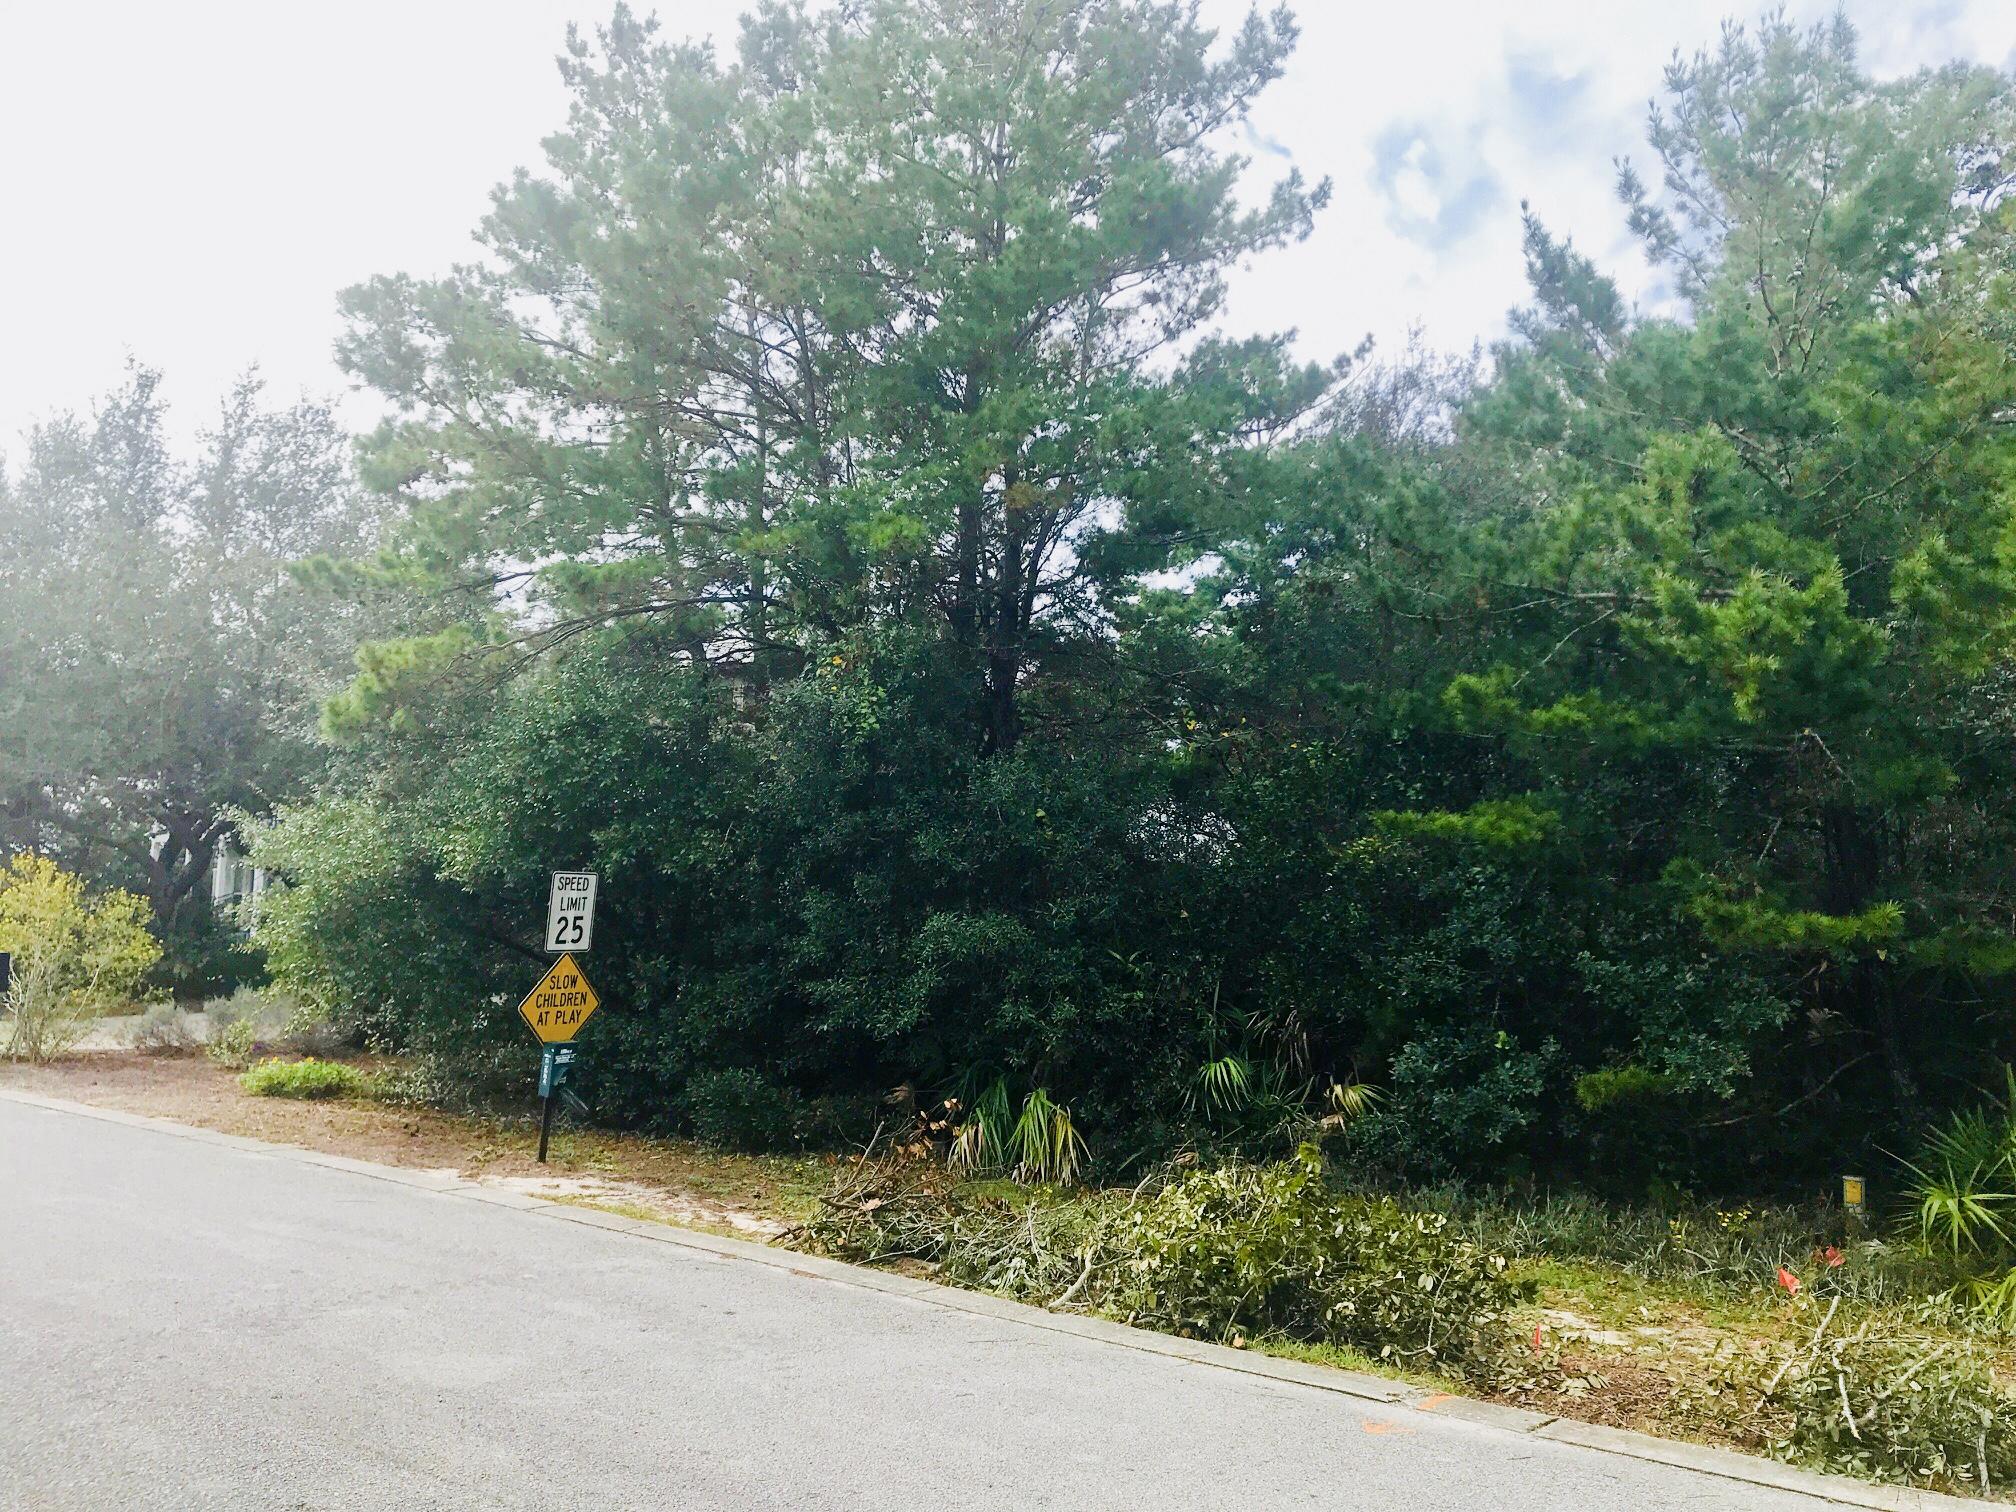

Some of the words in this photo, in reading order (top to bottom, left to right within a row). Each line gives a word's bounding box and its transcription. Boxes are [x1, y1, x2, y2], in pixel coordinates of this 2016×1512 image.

[558, 876, 589, 892] SPEED
[560, 896, 588, 911] LIMIT
[555, 916, 583, 944] 25
[549, 974, 578, 990] SLOW
[535, 991, 588, 1008] CHILDREN
[536, 1011, 550, 1026] AT
[554, 1009, 582, 1025] PLAY
